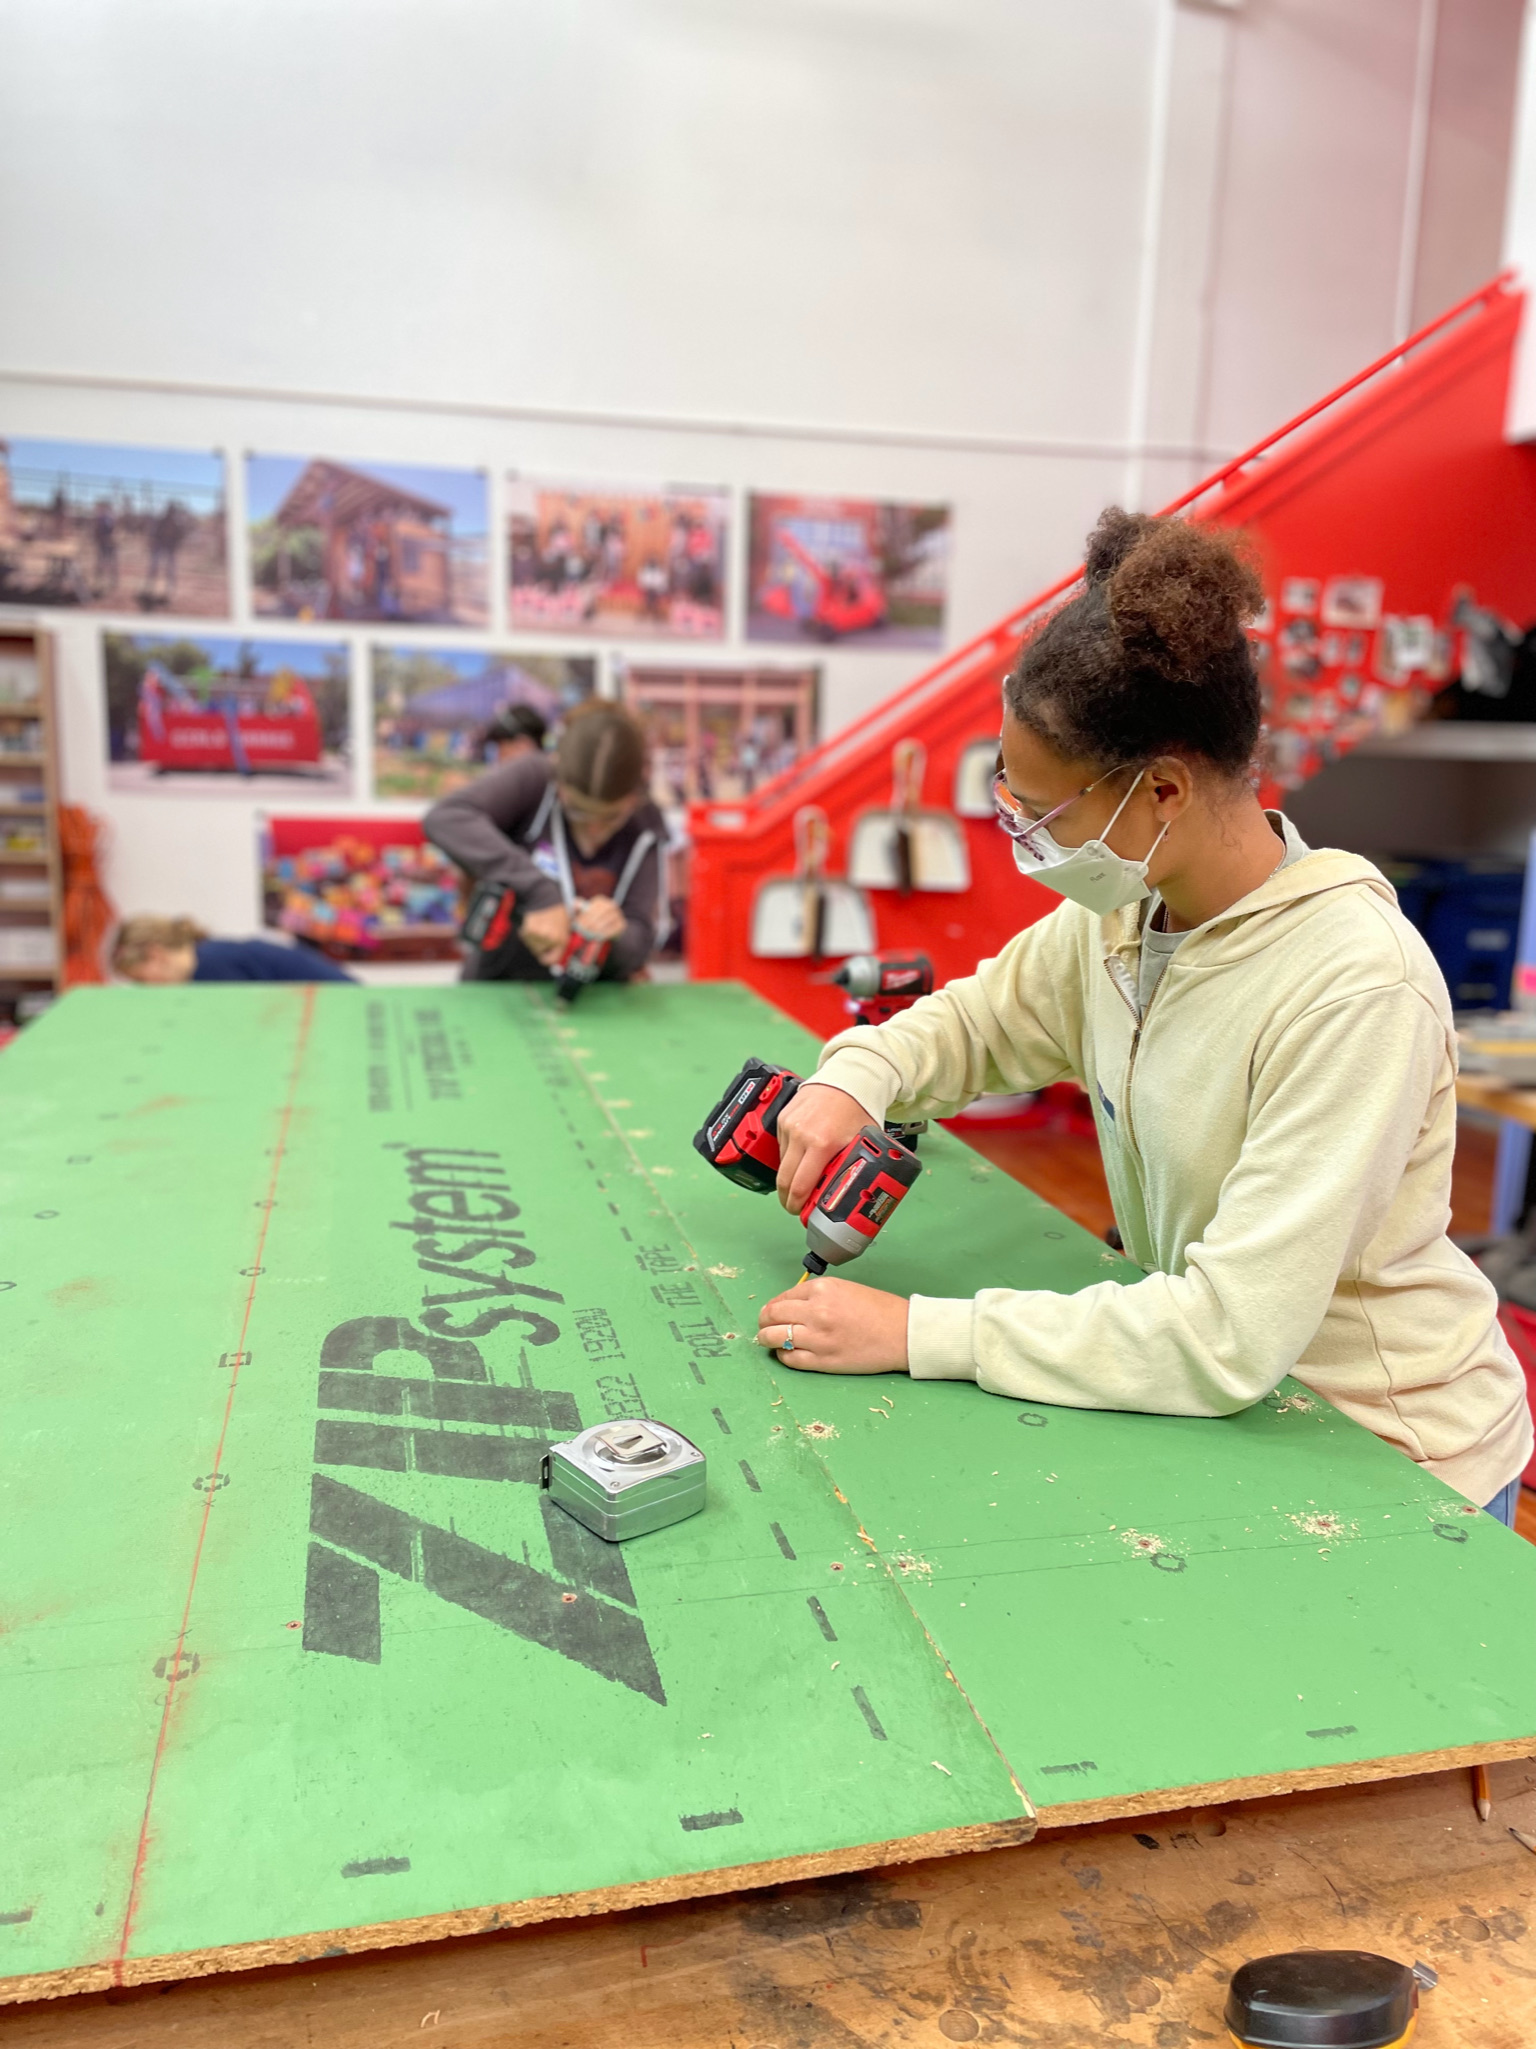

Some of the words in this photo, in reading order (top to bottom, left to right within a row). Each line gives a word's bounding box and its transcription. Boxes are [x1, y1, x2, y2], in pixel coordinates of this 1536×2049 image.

[637, 1243, 684, 1276] TAPE
[657, 1281, 702, 1308] THE
[679, 1316, 732, 1358] ROLL
[302, 1315, 668, 1707] ZIP
